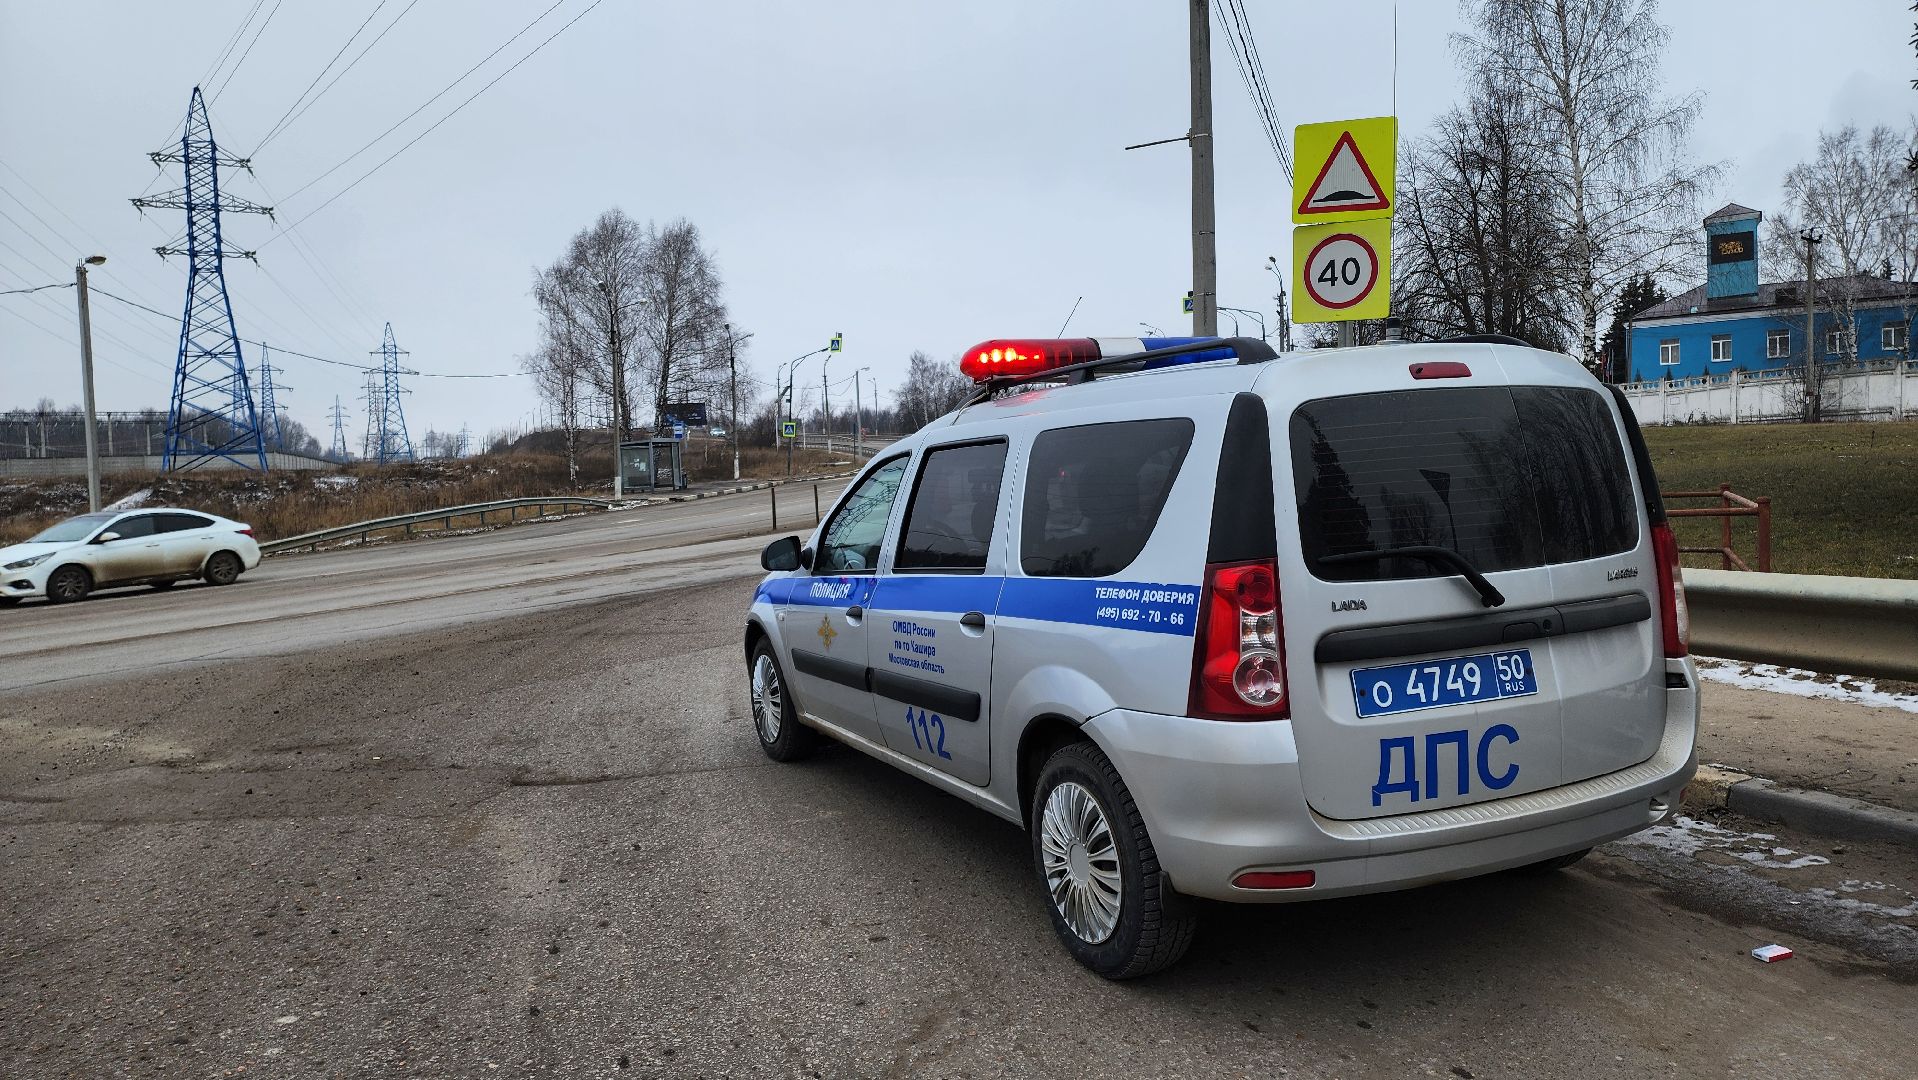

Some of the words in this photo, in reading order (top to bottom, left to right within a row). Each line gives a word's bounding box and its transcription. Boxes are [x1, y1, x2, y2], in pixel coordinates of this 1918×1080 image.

[1317, 257, 1361, 287] 40
[809, 582, 851, 601] ПОЛИЦИЯ
[1095, 587, 1140, 601] ТЕЛЕФОН
[1141, 589, 1195, 605] ДОВЕРИЯ
[1331, 599, 1368, 612] LADA
[1096, 606, 1120, 622] (495)
[1121, 608, 1140, 621] 692
[1148, 610, 1161, 623] 70
[1170, 612, 1185, 625] 66
[892, 620, 912, 636] ОМВД
[912, 622, 936, 638] России
[1498, 654, 1525, 682] 50
[1406, 661, 1482, 703] 4749
[1505, 681, 1525, 692] RUS
[905, 706, 953, 761] 112
[1371, 723, 1520, 807] ДПС
